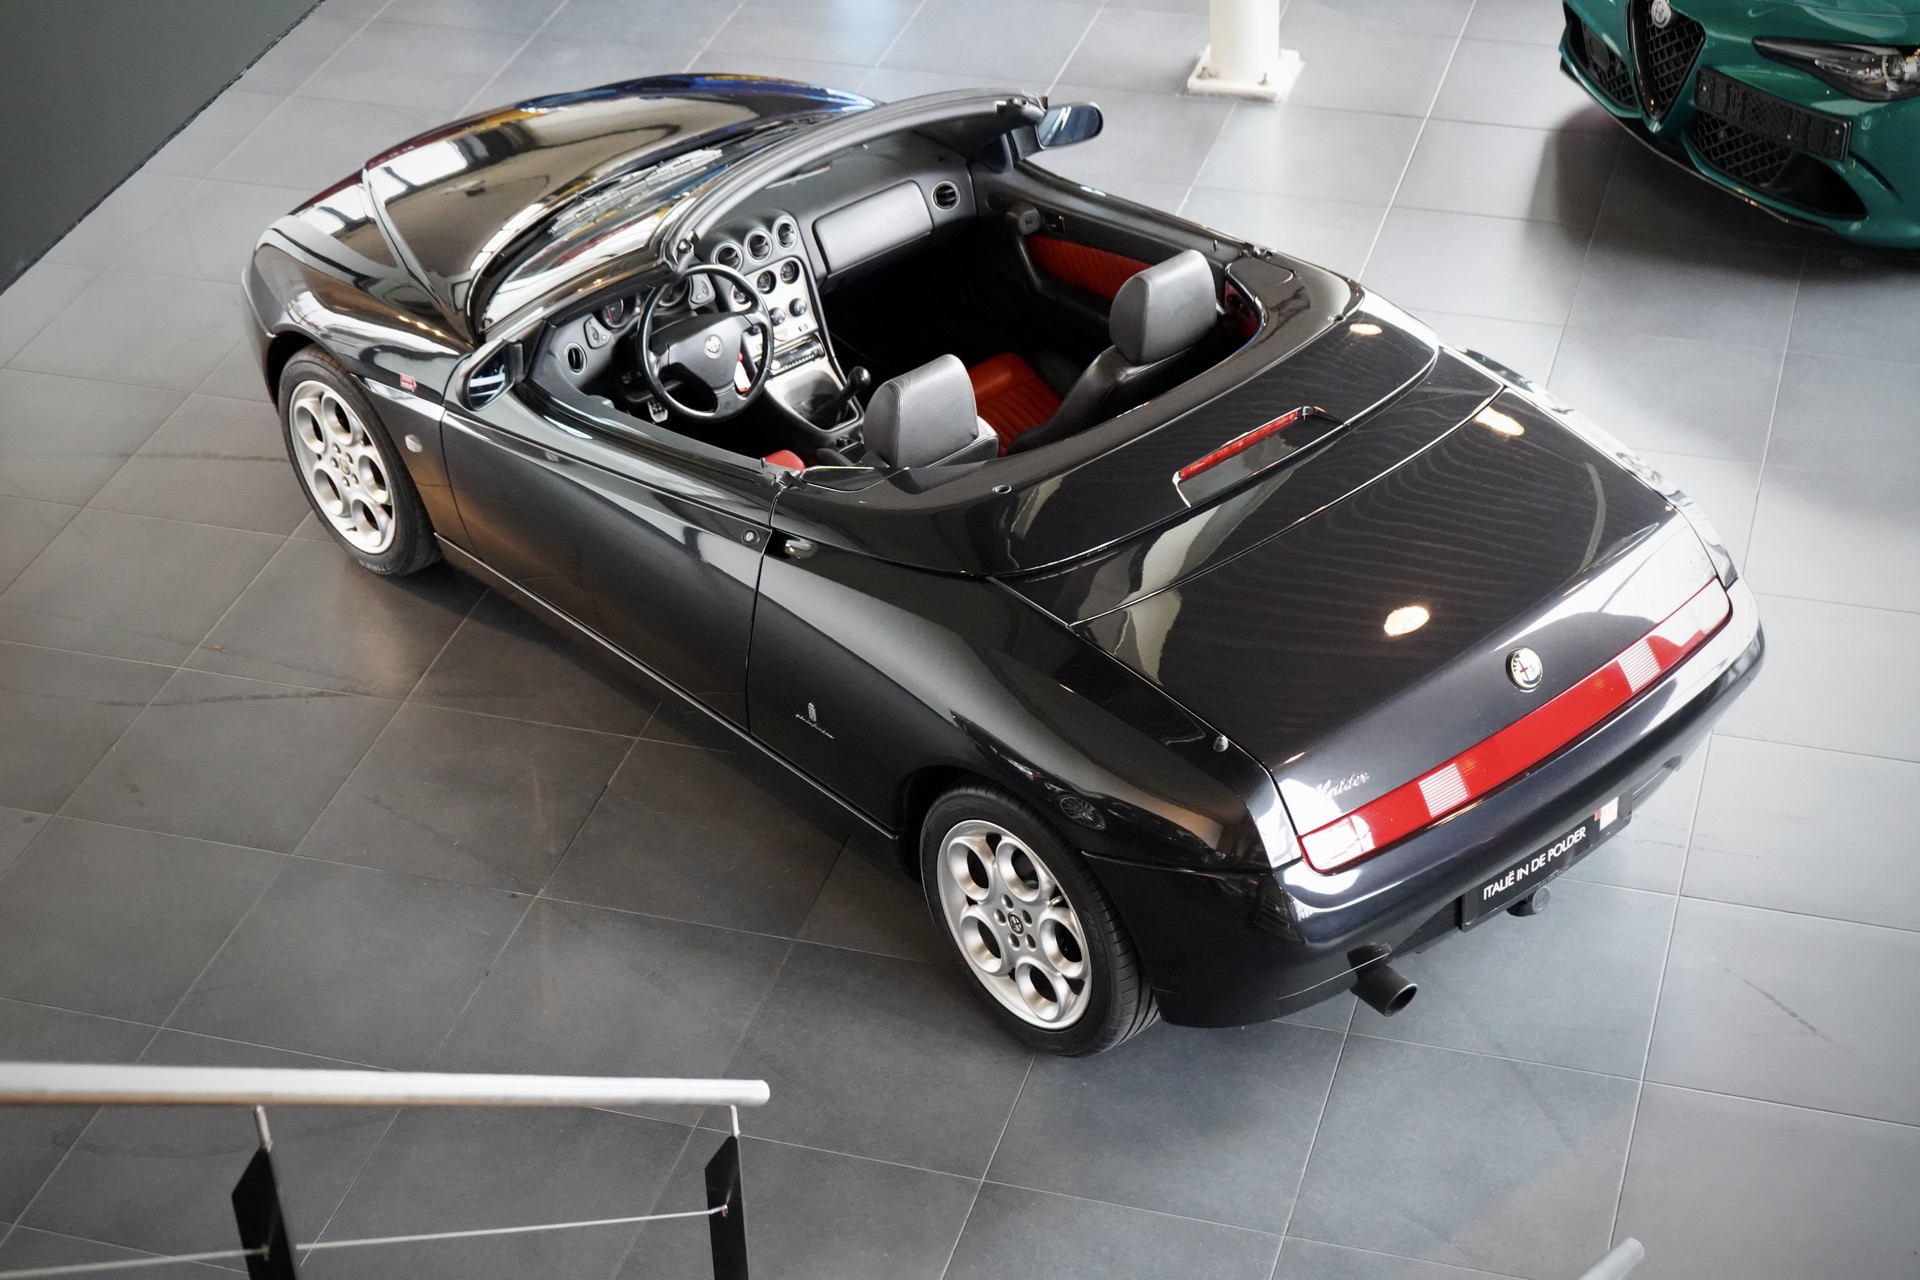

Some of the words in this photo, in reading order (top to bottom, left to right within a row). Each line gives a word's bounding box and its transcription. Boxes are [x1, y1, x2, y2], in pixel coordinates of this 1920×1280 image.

[1483, 870, 1515, 900] ITALIË
[1516, 864, 1529, 882] IN
[1531, 855, 1546, 873] DE
[1548, 826, 1587, 862] POLDER
